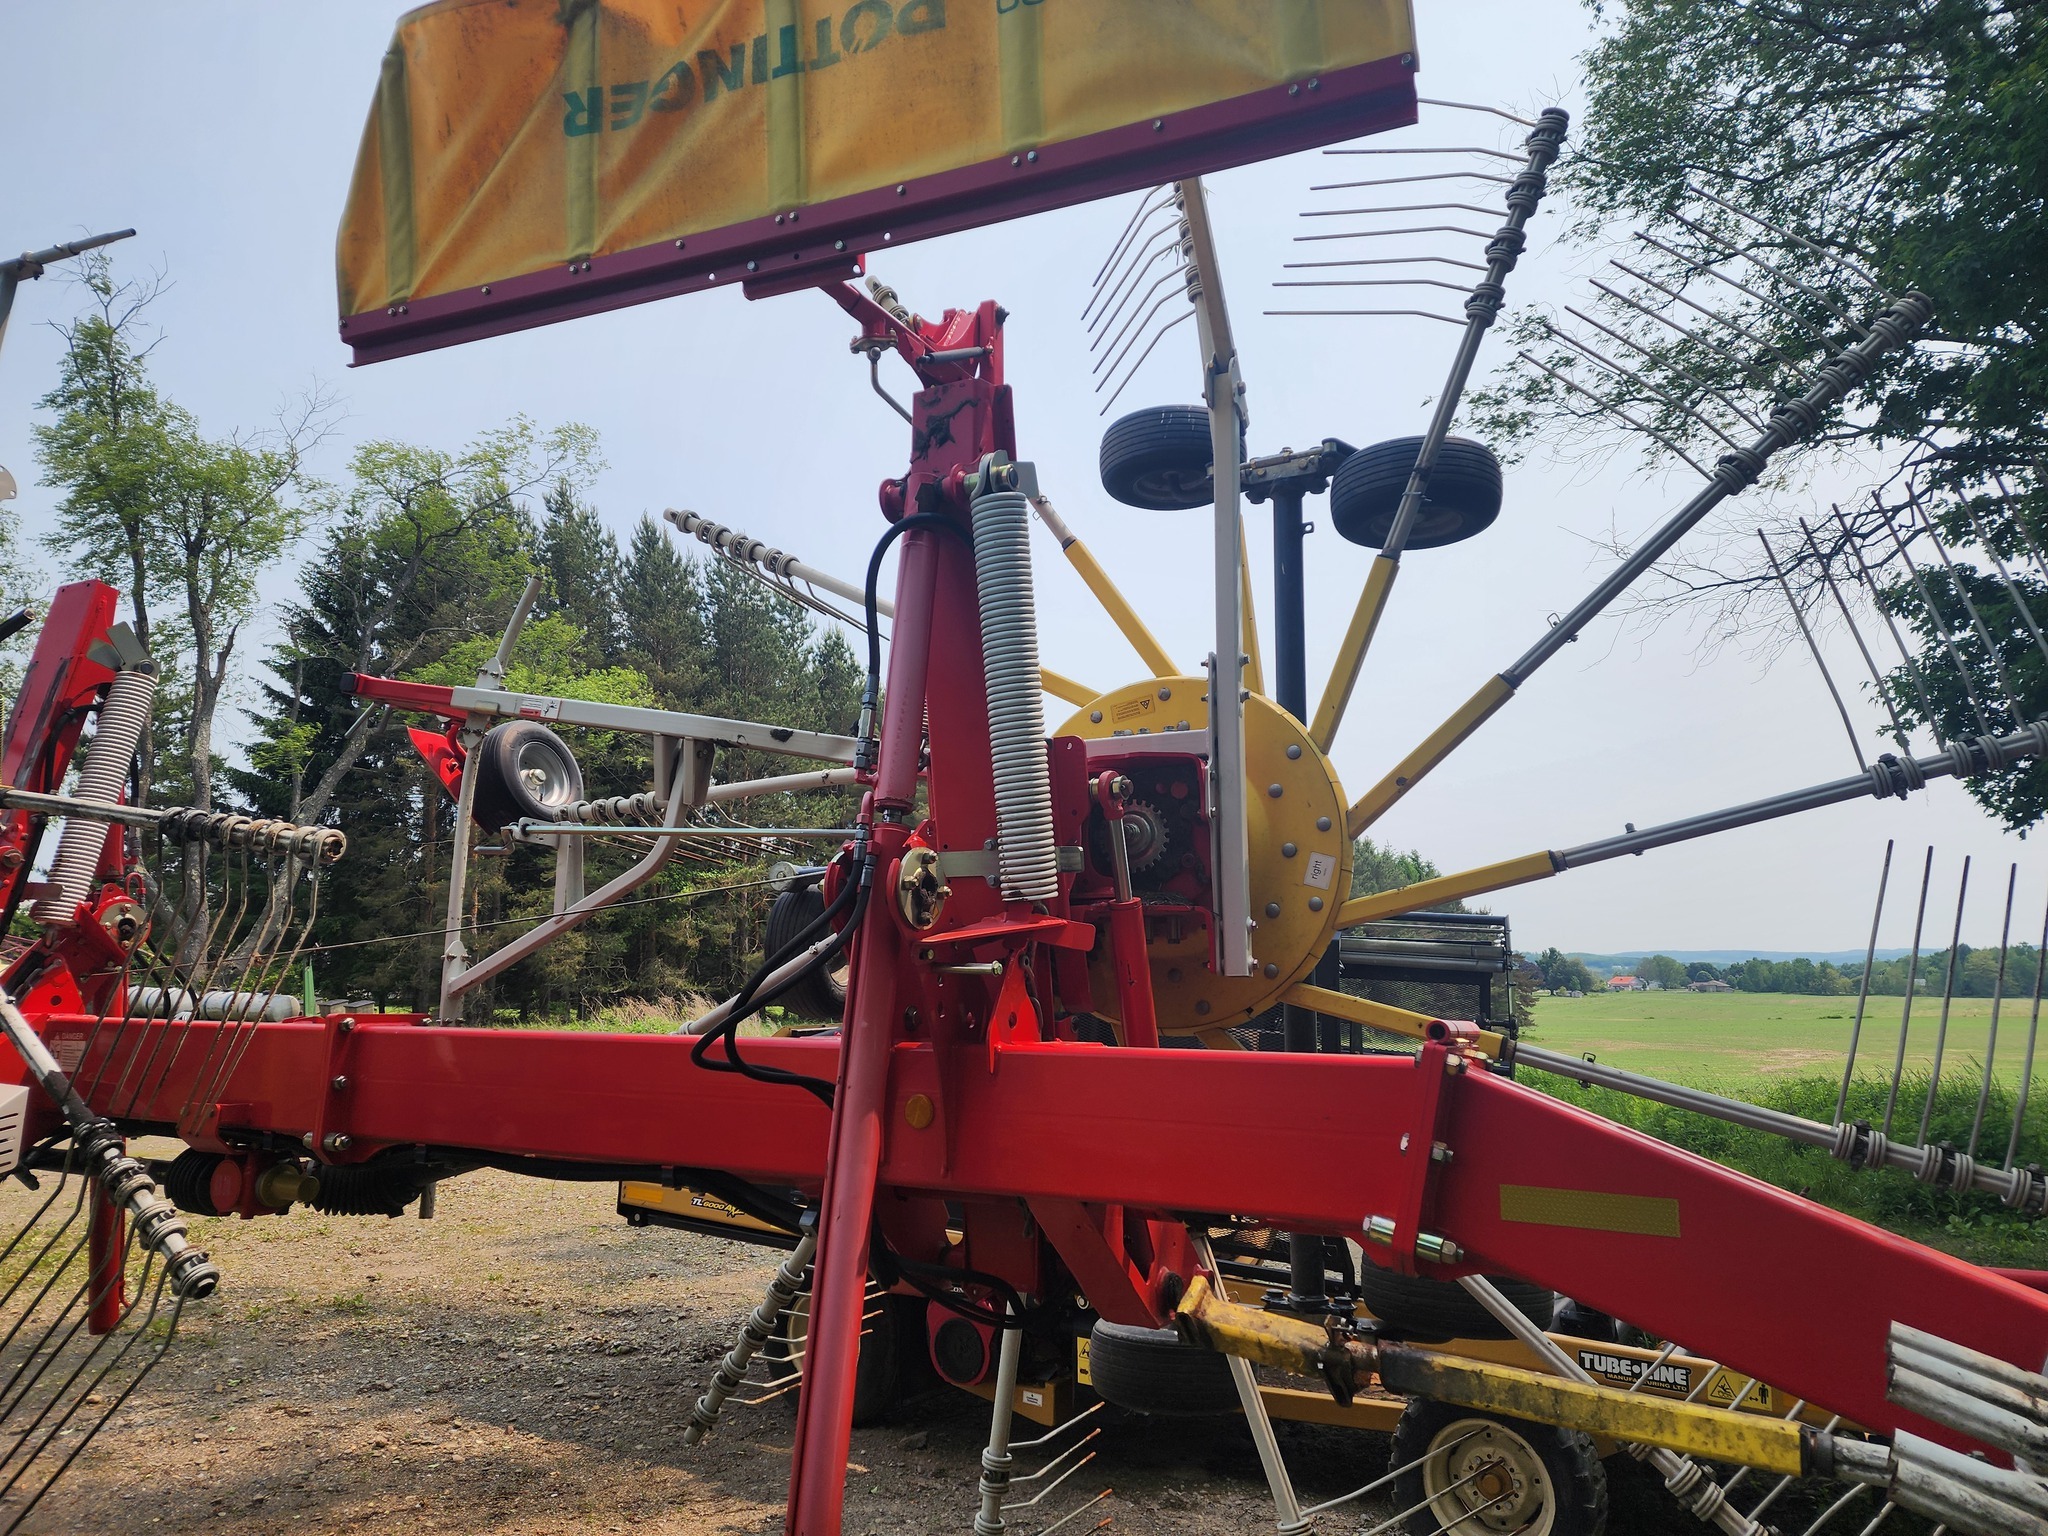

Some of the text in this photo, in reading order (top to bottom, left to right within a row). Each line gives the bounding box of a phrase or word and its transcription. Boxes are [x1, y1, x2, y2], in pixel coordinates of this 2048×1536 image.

[1311, 860, 1322, 880] right
[62, 1032, 84, 1040] DANGER
[1607, 1373, 1671, 1388] MANUFATURING
